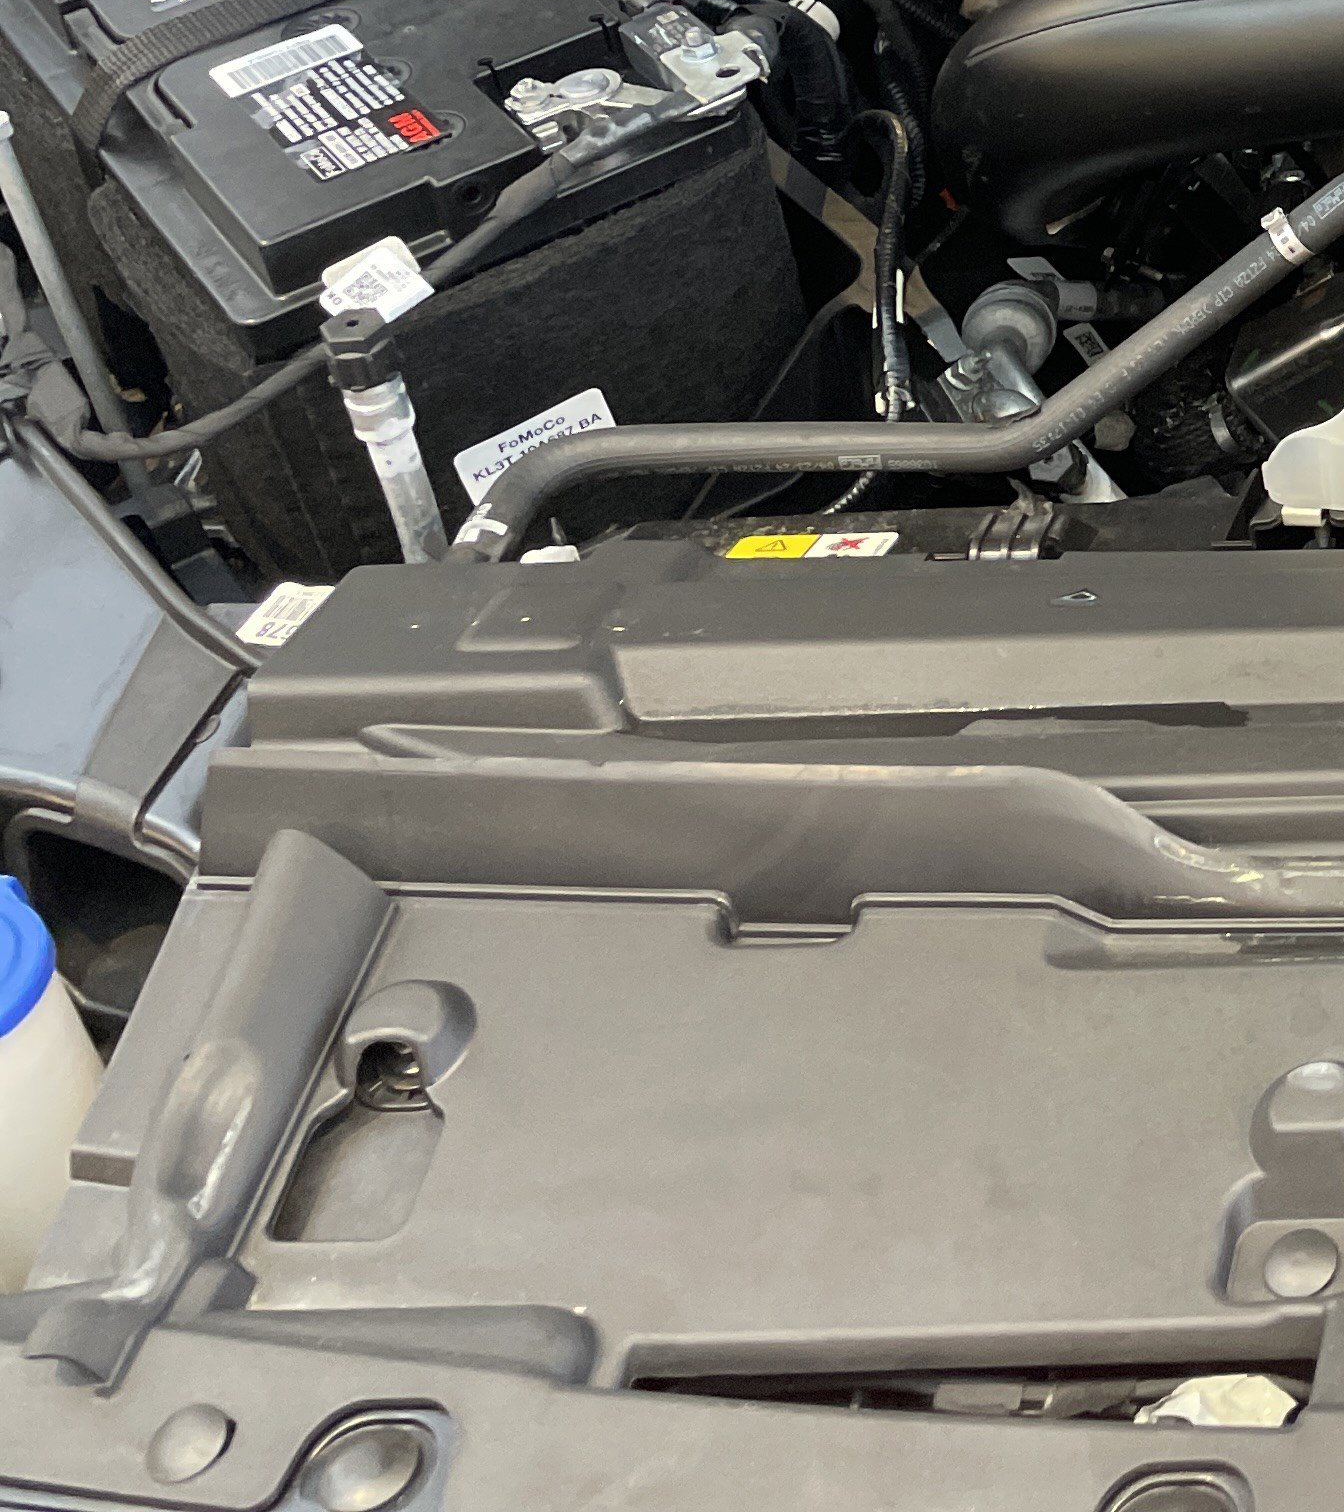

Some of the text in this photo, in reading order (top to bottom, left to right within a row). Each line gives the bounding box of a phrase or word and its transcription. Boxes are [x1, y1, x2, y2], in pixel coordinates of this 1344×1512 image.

[472, 455, 515, 482] KL3T
[578, 413, 603, 430] BA
[498, 415, 566, 453] FoMoCo
